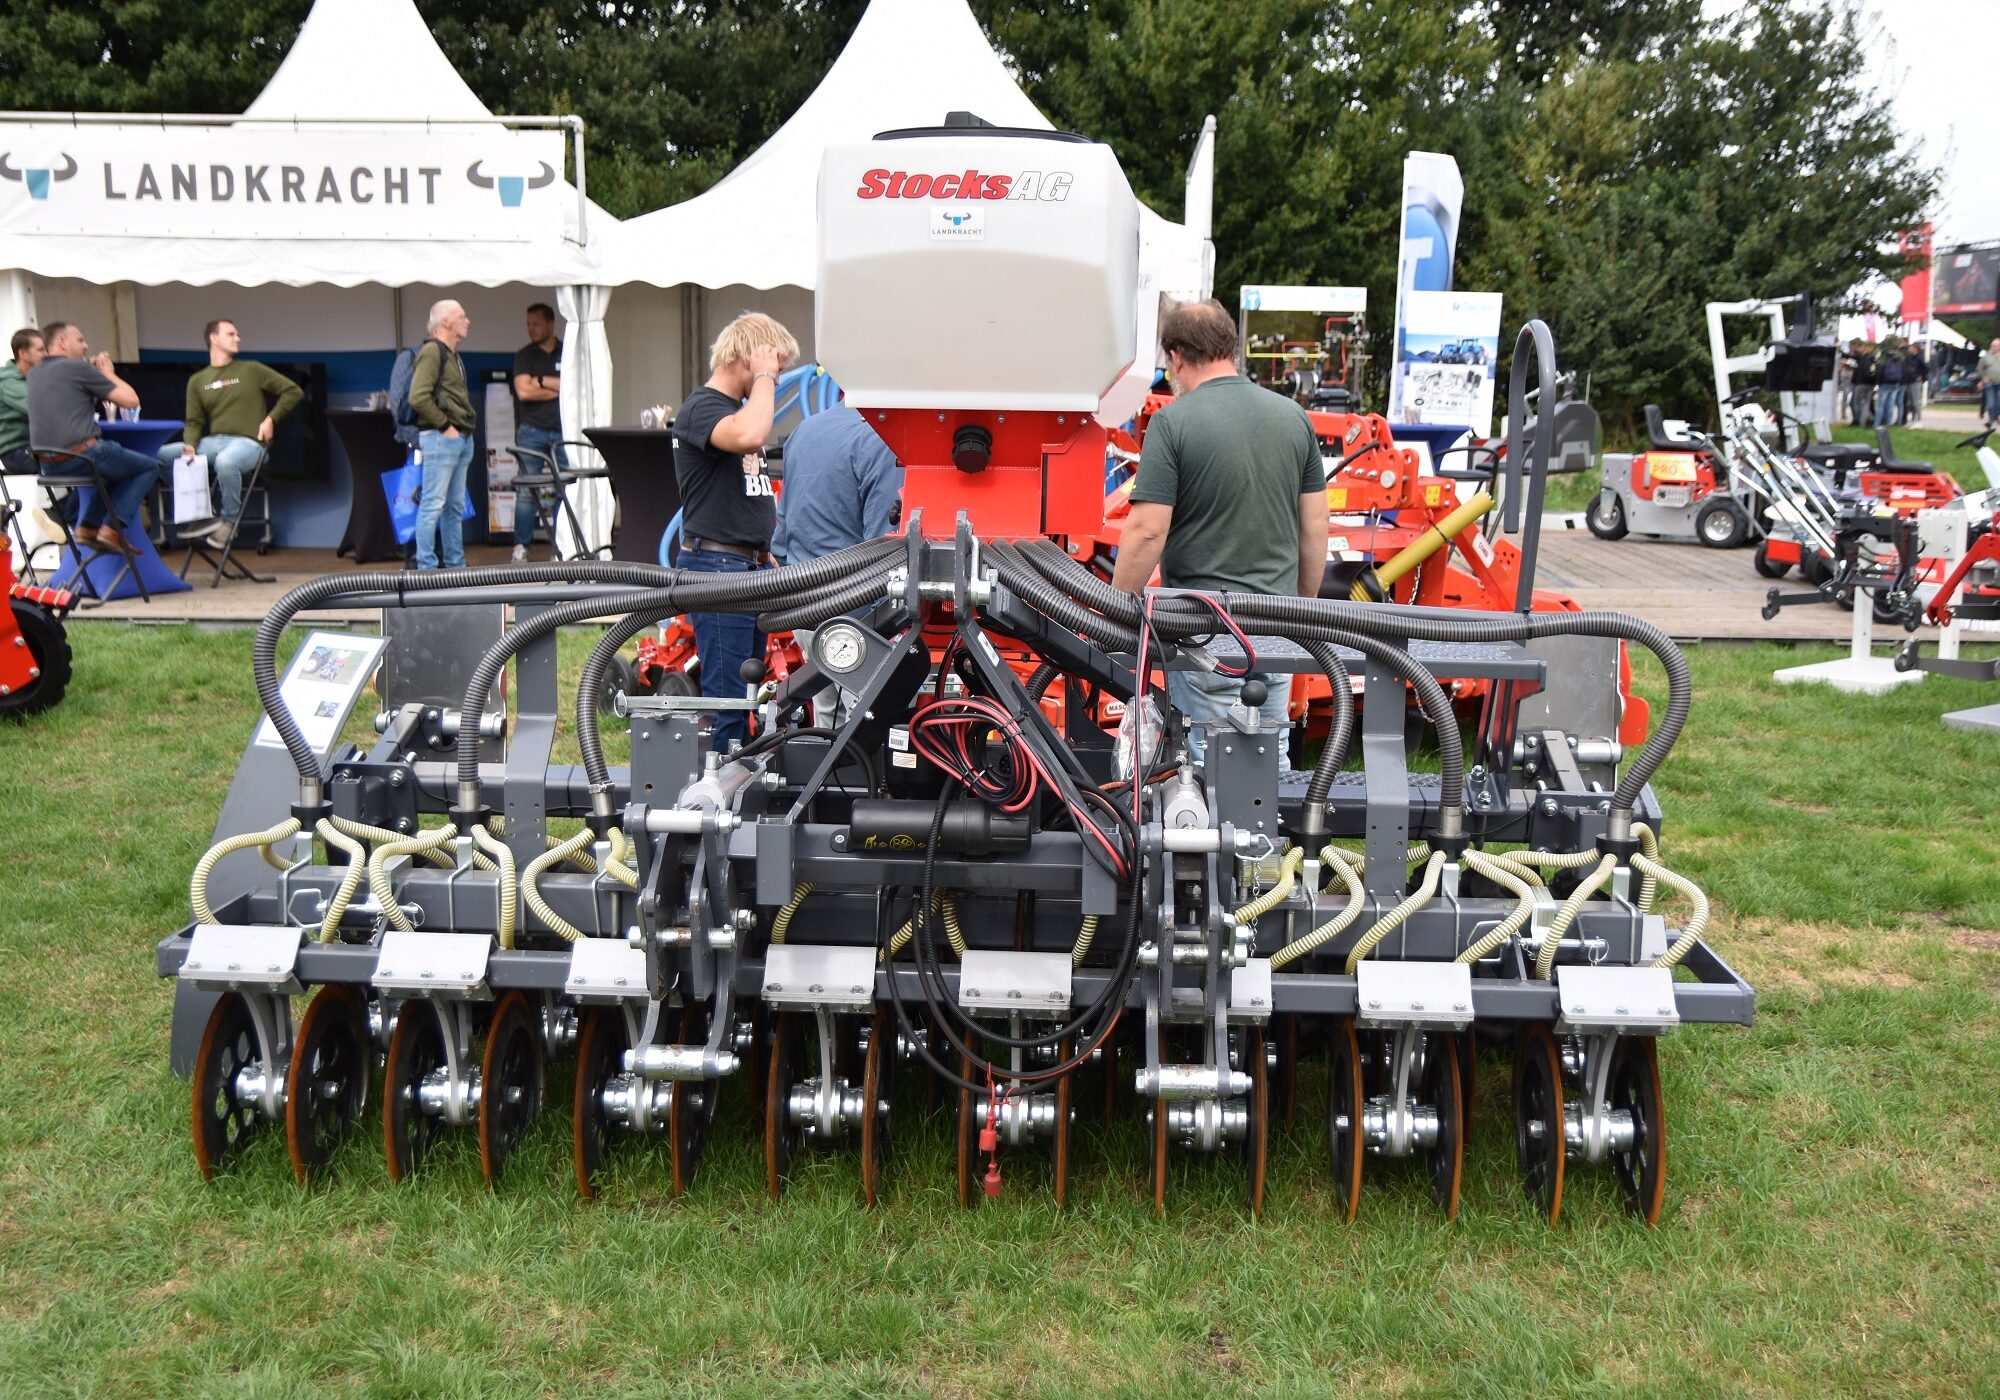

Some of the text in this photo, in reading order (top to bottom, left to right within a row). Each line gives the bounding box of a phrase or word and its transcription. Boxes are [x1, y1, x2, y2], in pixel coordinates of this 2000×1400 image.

[103, 162, 442, 205] LANDKRACHT
[856, 167, 1075, 202] StocksAG
[1653, 463, 1678, 476] PRO
